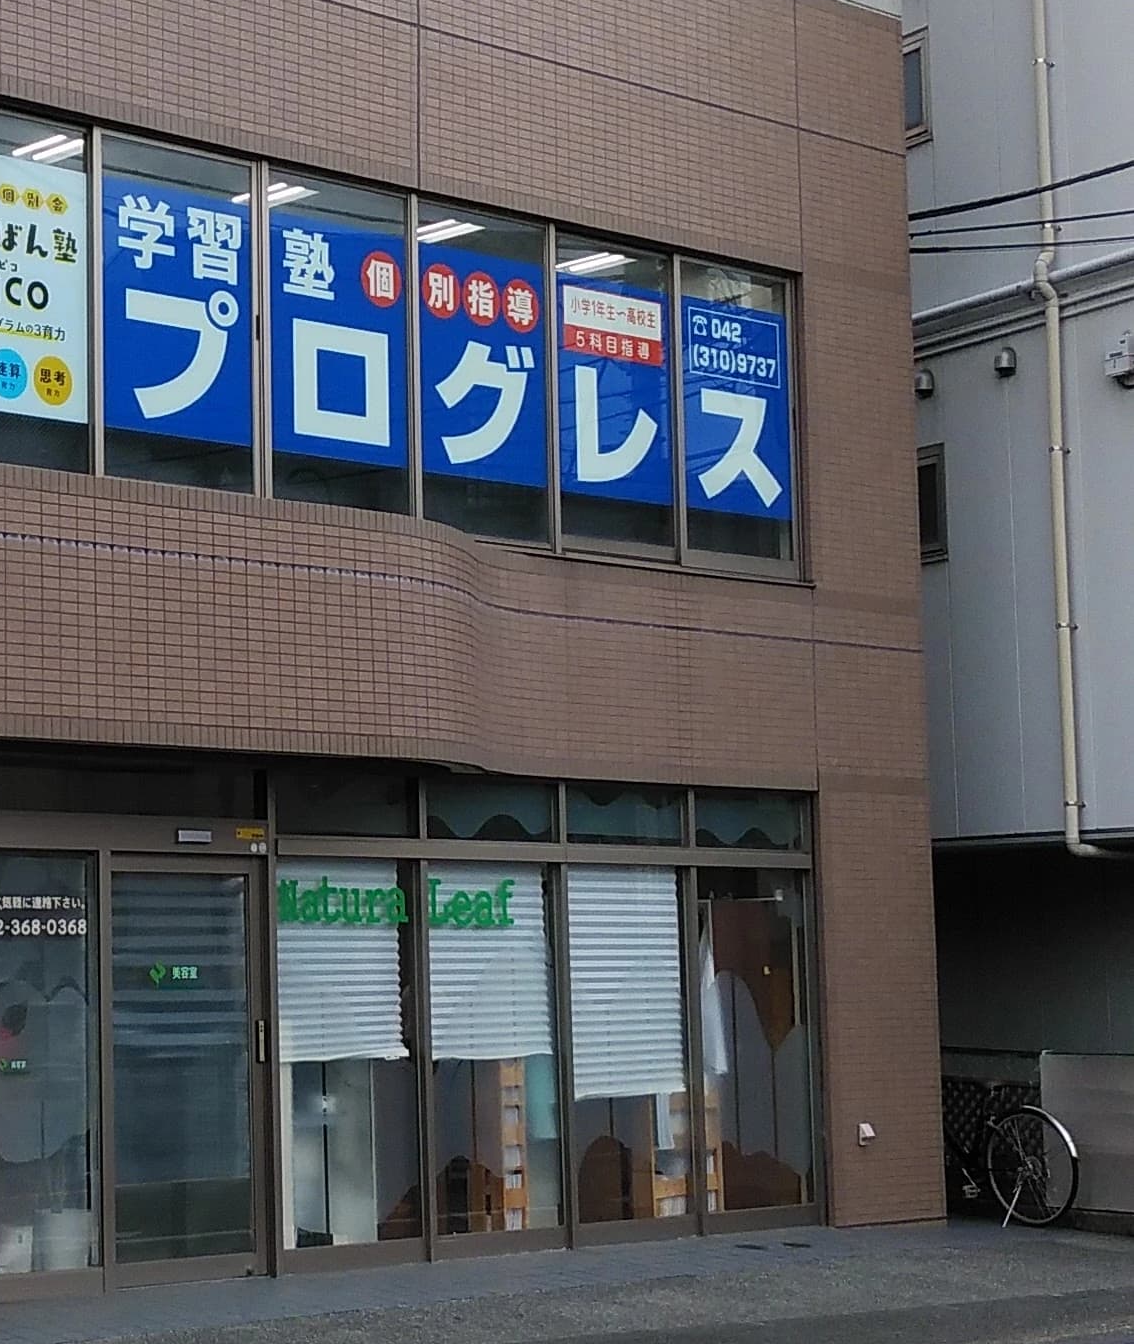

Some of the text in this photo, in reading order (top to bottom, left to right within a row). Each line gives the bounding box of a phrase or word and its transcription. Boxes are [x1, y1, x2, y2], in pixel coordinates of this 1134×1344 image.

[118, 195, 336, 302] 学習塾
[365, 260, 539, 328] 個別指導
[711, 318, 742, 344] 042
[39, 367, 66, 386] 思考
[692, 343, 777, 380] (310)9737
[124, 288, 783, 509] プログレス
[428, 877, 516, 928] Leaf
